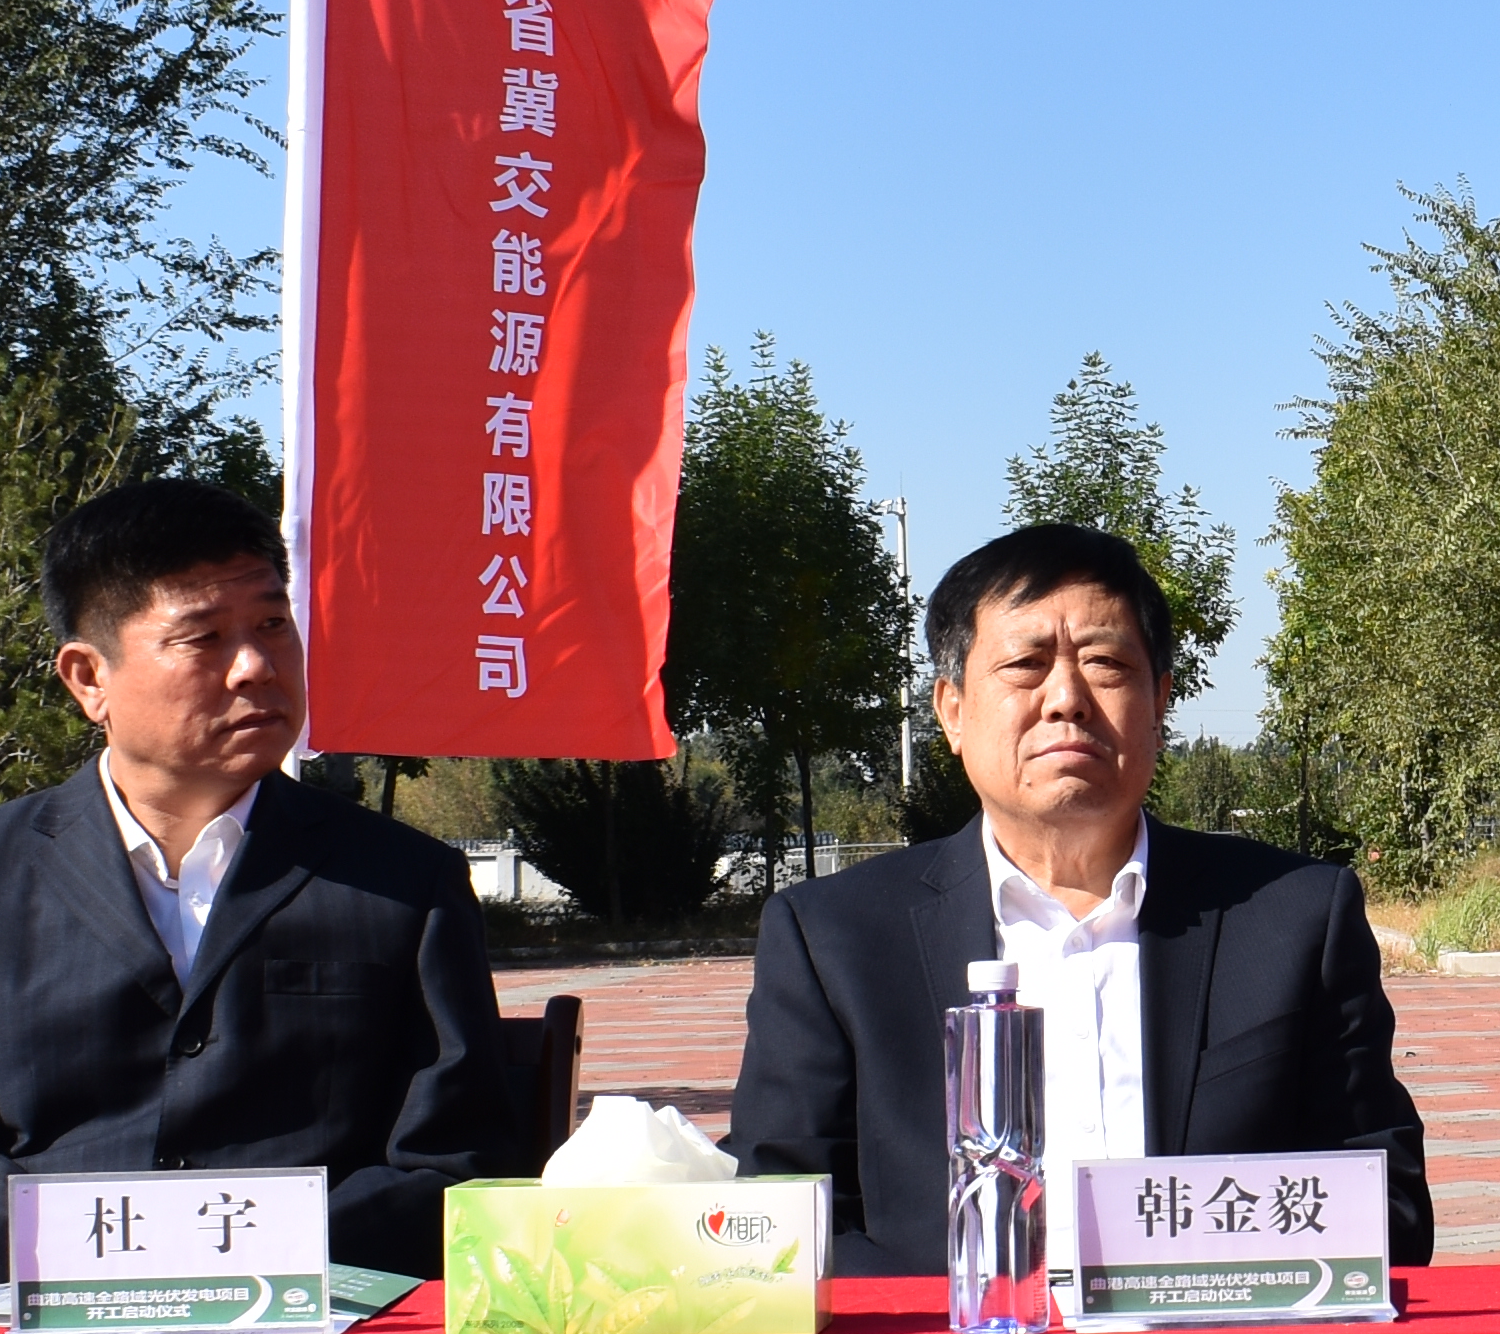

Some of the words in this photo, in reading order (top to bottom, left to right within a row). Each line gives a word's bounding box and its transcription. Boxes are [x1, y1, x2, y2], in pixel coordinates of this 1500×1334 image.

[1134, 1175, 1329, 1238] 韩金毅
[1090, 1271, 1311, 1291] 曲港高速全路域光伏发电项目
[27, 1287, 250, 1306] 曲港高速全路域光伏发电项目
[1149, 1288, 1253, 1305] 开工启动仪式
[86, 1304, 191, 1320] 开工启动仪式
